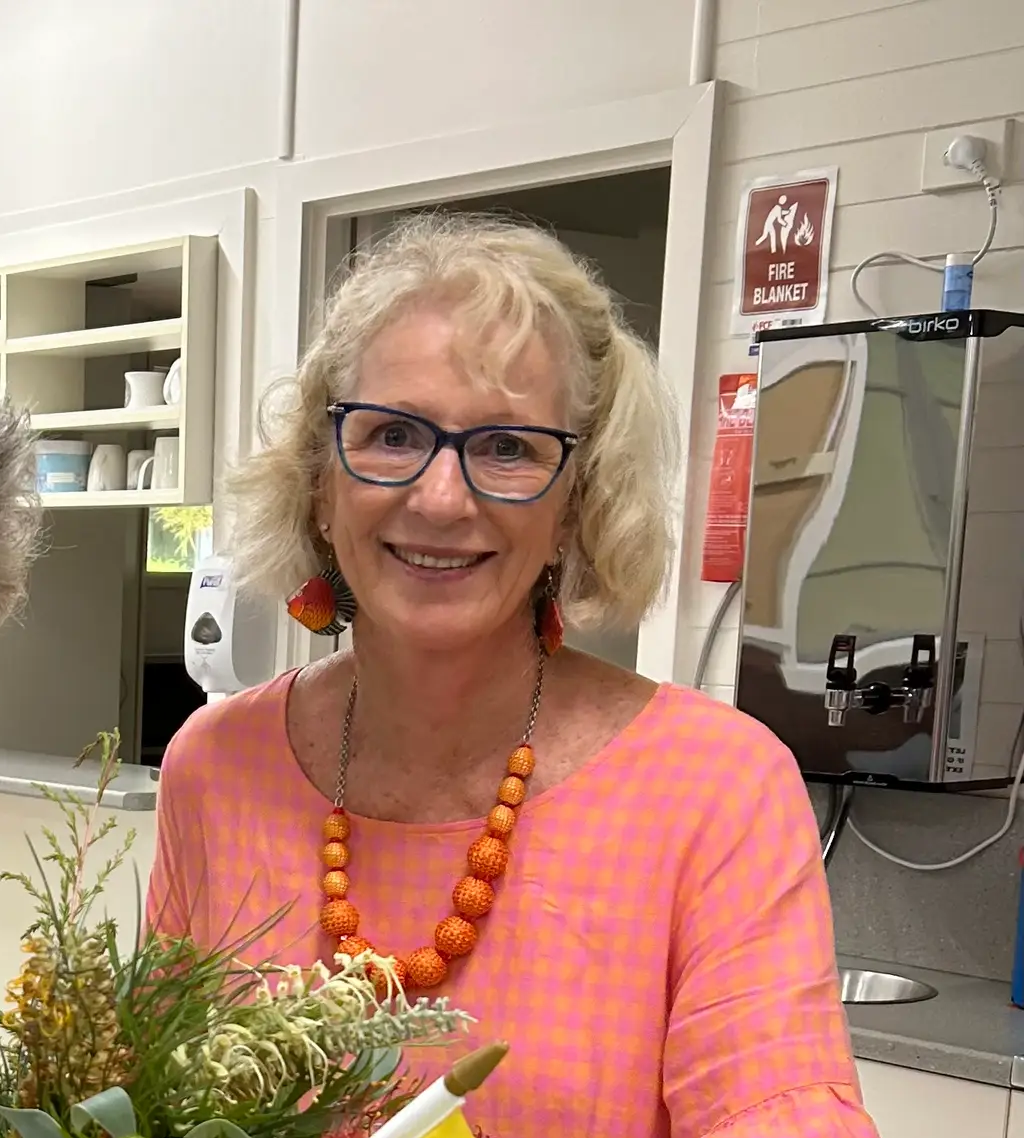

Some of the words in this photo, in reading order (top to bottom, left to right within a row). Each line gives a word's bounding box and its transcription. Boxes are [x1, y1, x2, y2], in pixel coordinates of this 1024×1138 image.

[768, 261, 795, 282] FIRE
[753, 283, 808, 305] BLANKET
[909, 316, 959, 334] birko
